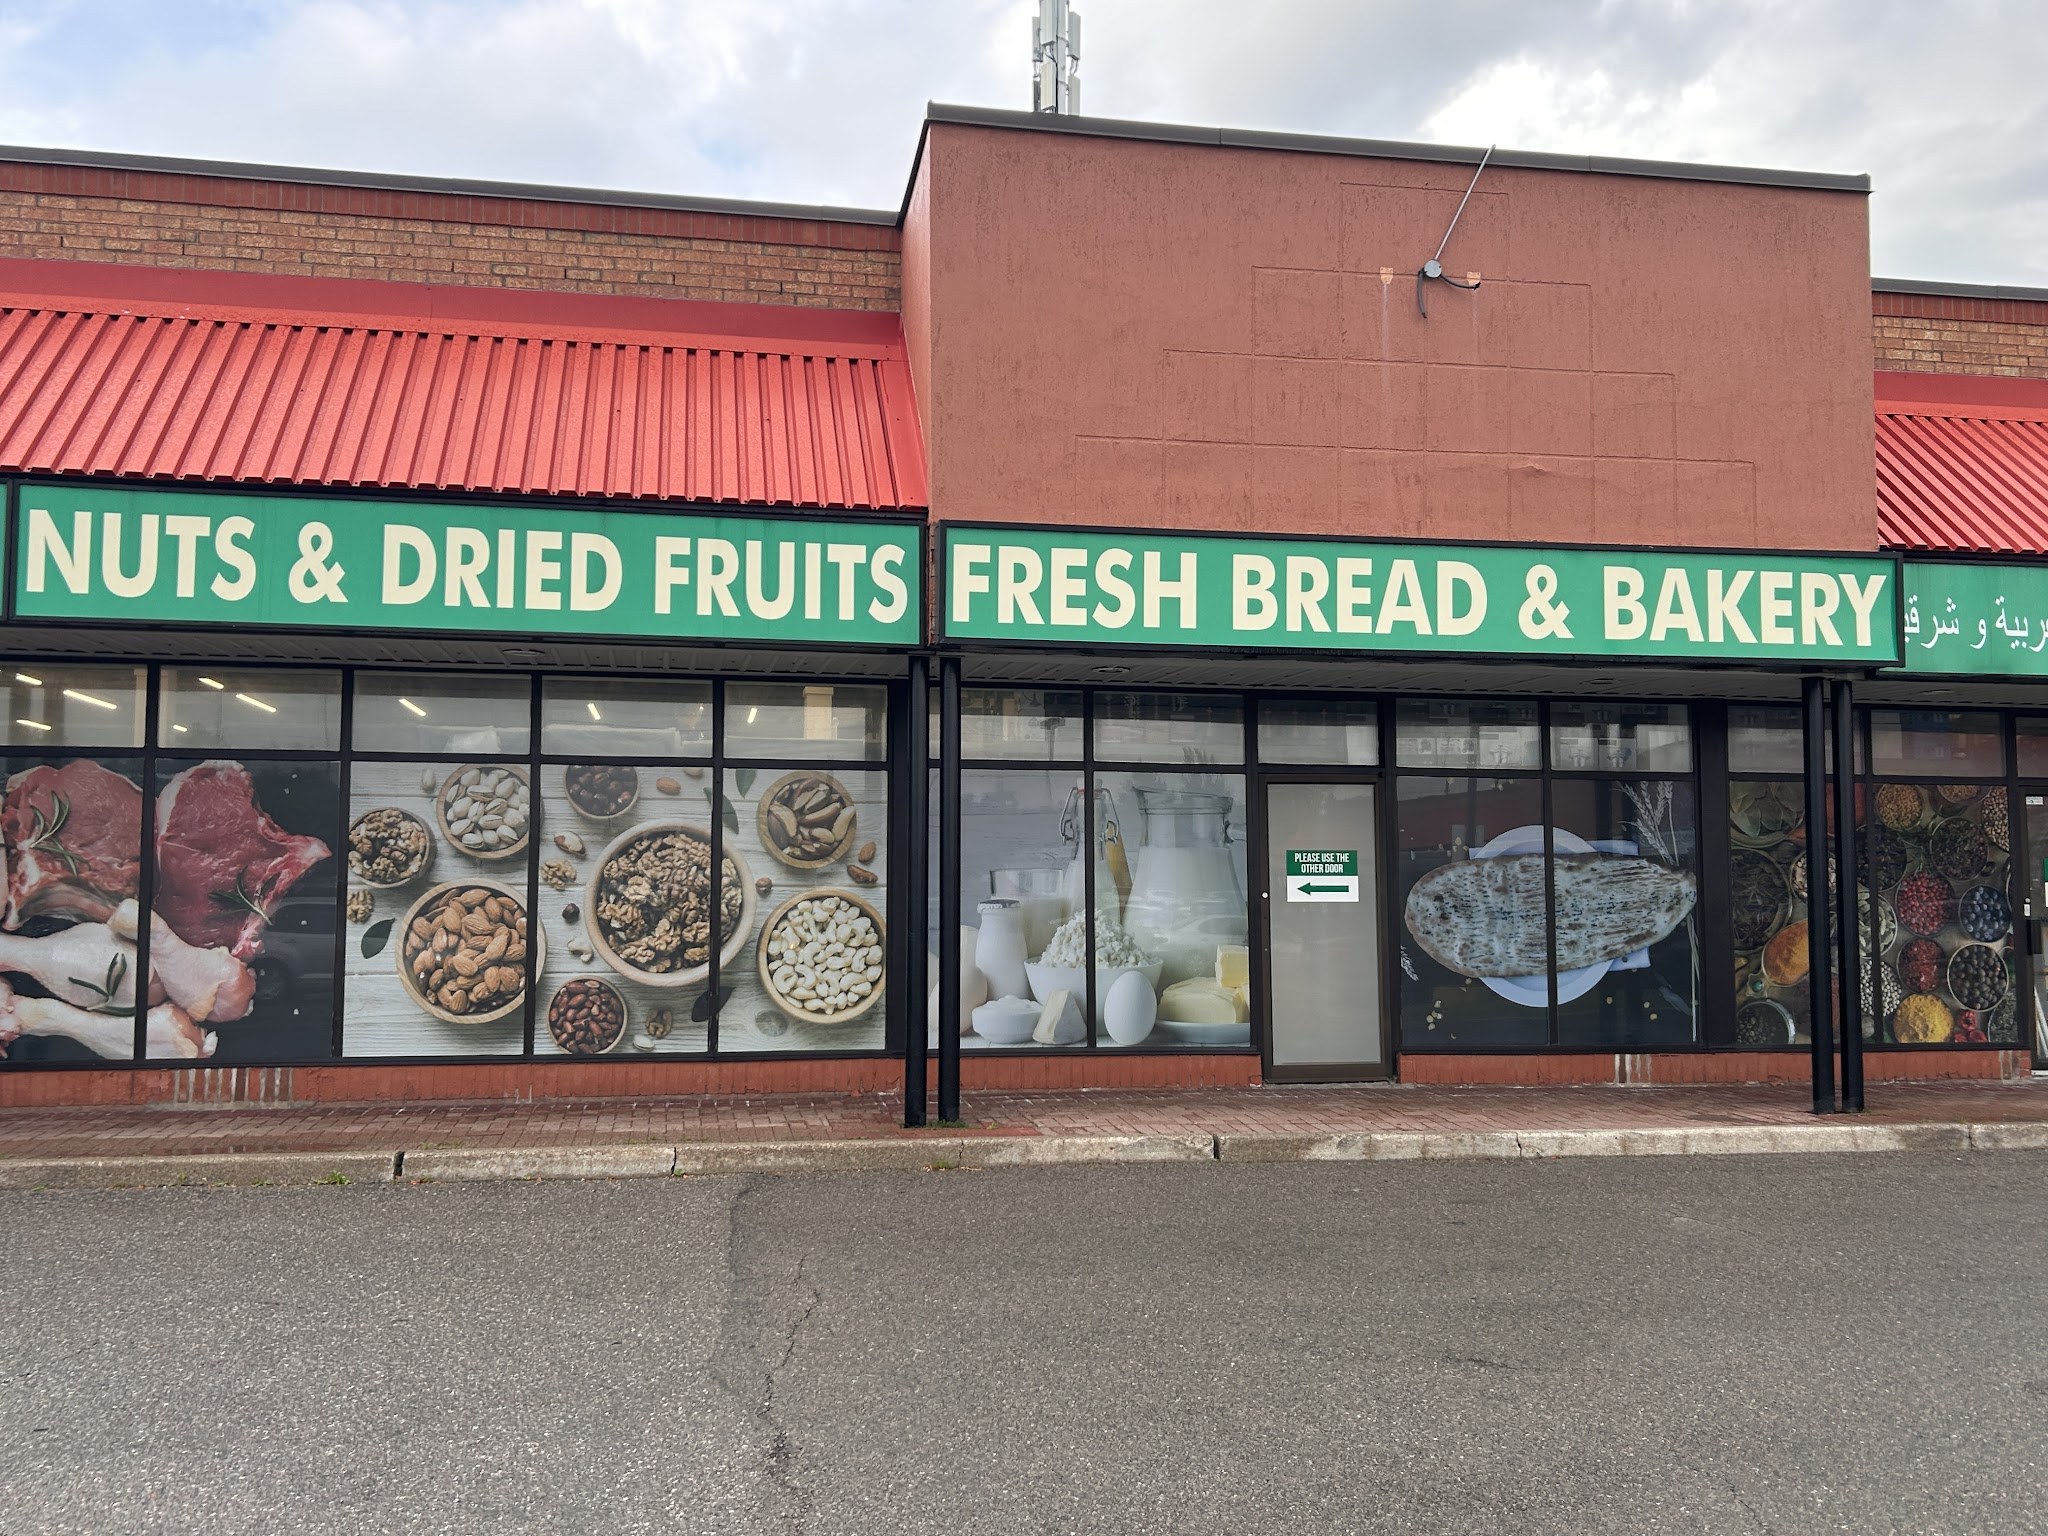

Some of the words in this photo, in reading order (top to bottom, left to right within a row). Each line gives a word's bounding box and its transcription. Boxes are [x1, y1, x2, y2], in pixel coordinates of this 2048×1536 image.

[27, 510, 256, 603] NUTS
[289, 522, 348, 603] &
[383, 525, 622, 612] DRIED
[655, 537, 907, 623] FRUITS
[953, 544, 1196, 629] FRESH
[1233, 554, 1487, 636] BREAD
[1519, 565, 1574, 640] &
[1604, 566, 1886, 647] BAKERY
[1904, 594, 1959, 649] شرقي
[1970, 618, 1986, 649] و
[1294, 852, 1320, 863] PLEASE
[1321, 852, 1335, 863] USE
[1335, 852, 1350, 863] THE
[1301, 863, 1324, 873] OTHER
[1324, 863, 1344, 873] DOOR
